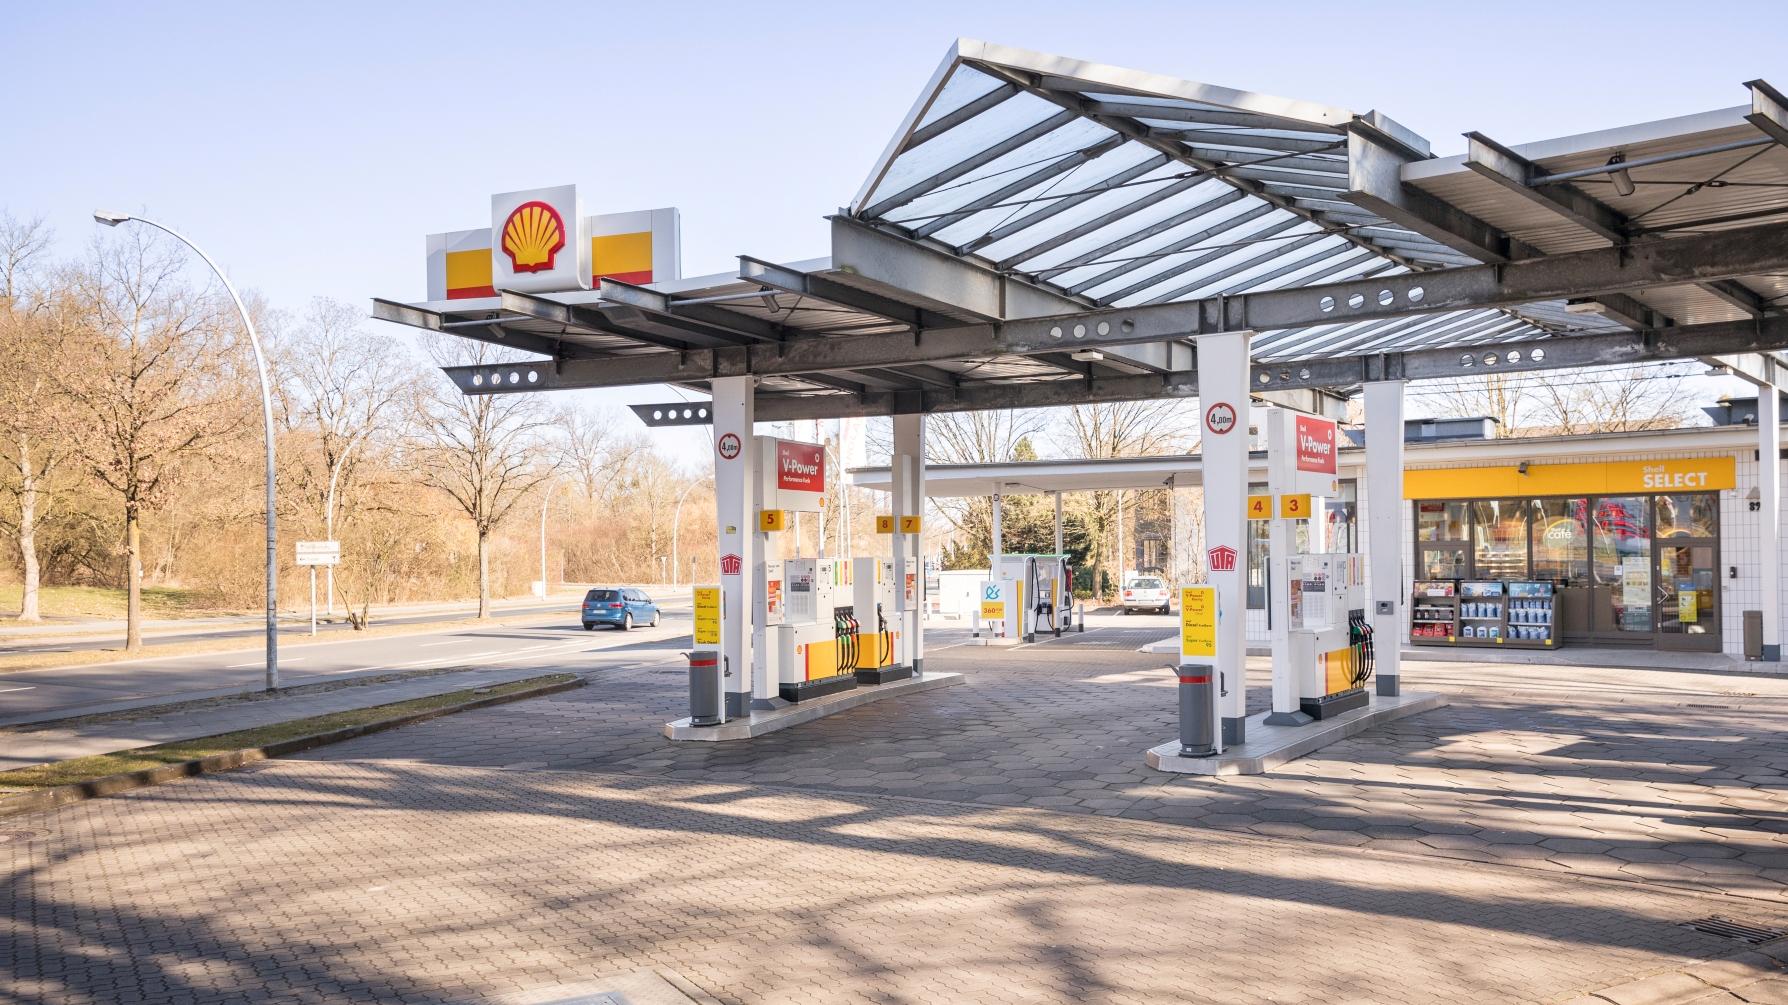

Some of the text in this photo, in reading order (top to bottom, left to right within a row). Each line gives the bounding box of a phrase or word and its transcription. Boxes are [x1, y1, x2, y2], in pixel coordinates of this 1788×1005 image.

[1301, 434, 1331, 454] V-Power
[783, 458, 818, 475] V-Power
[1643, 465, 1665, 473] Shell
[1643, 472, 1708, 488] SELECT
[1253, 500, 1264, 512] 4
[1290, 499, 1299, 511] 3
[767, 513, 775, 525] 5
[882, 519, 889, 529] 8
[905, 519, 913, 529] 7
[1548, 529, 1571, 540] café
